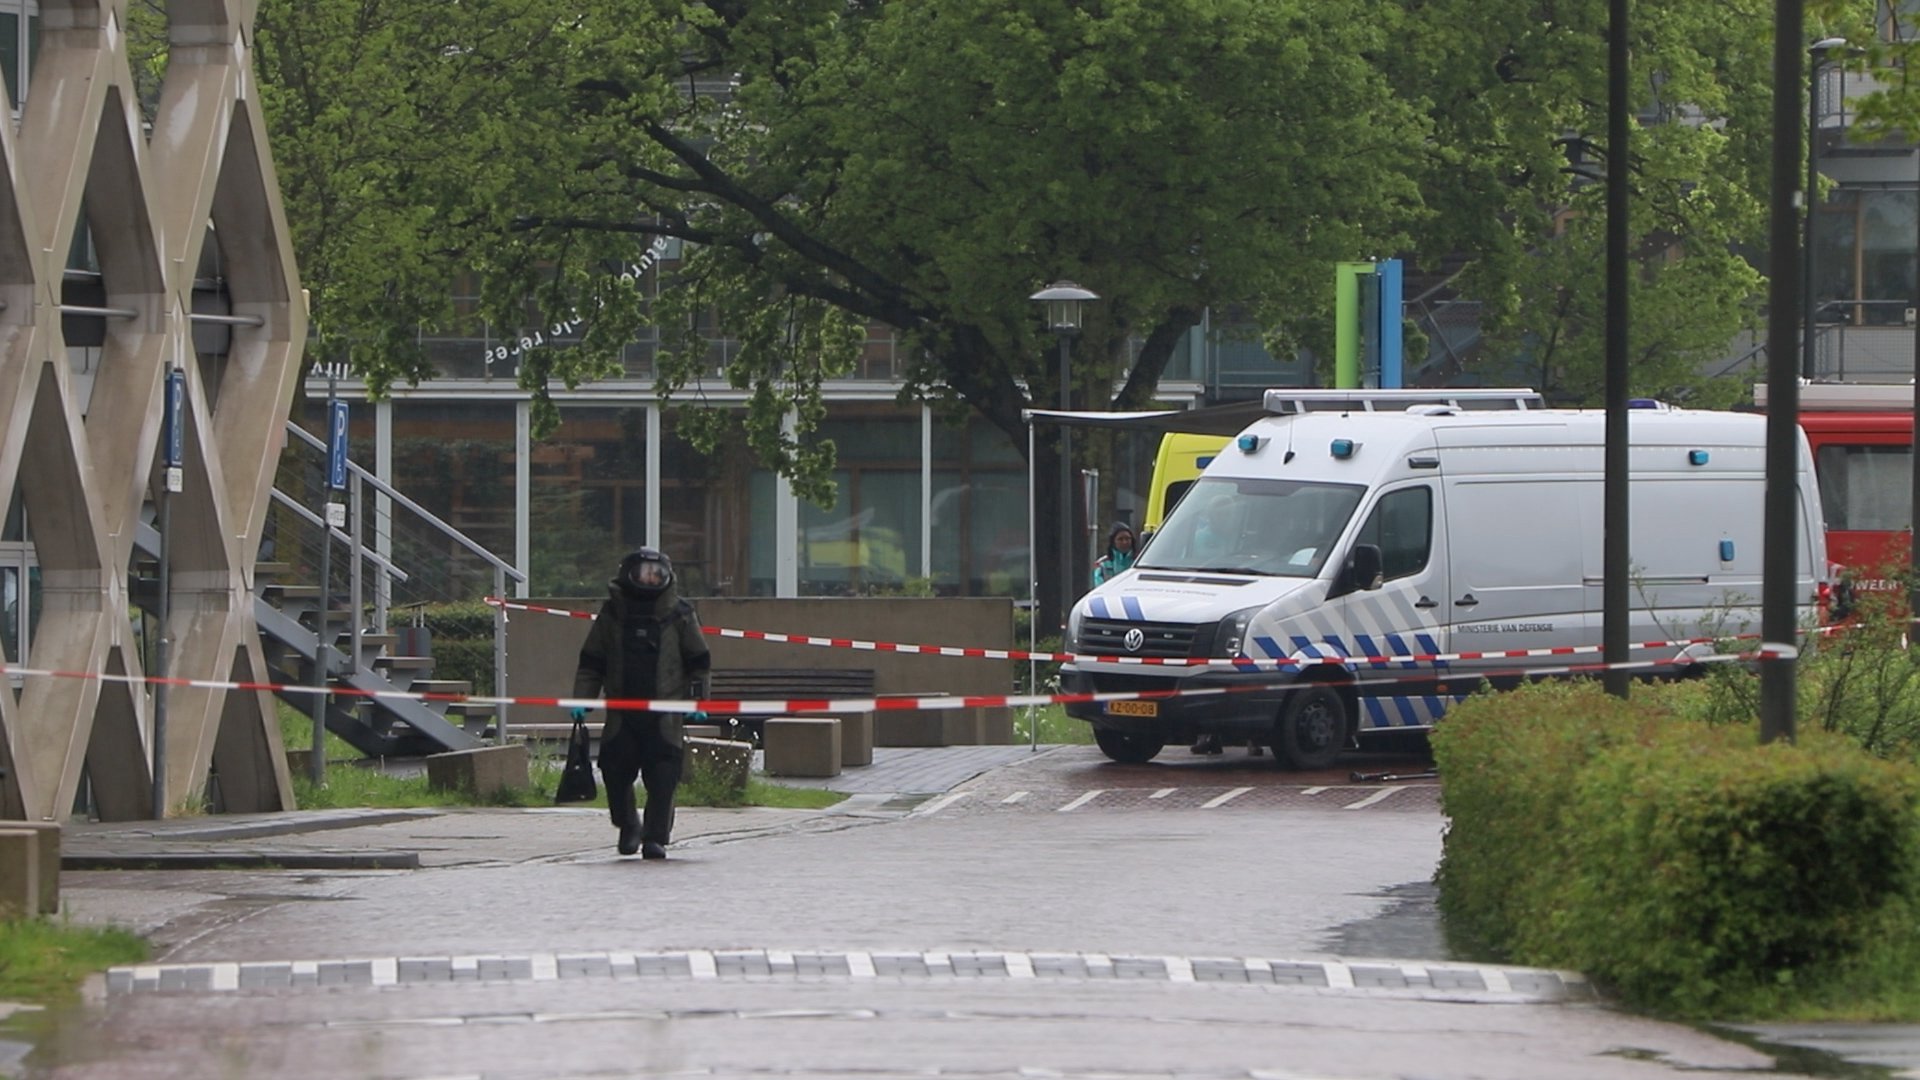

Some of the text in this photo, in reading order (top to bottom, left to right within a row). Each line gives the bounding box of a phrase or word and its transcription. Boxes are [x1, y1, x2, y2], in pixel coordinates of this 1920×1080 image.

[336, 409, 345, 451] P
[1457, 623, 1553, 634] MINISTERIE VAN DEFENSIE
